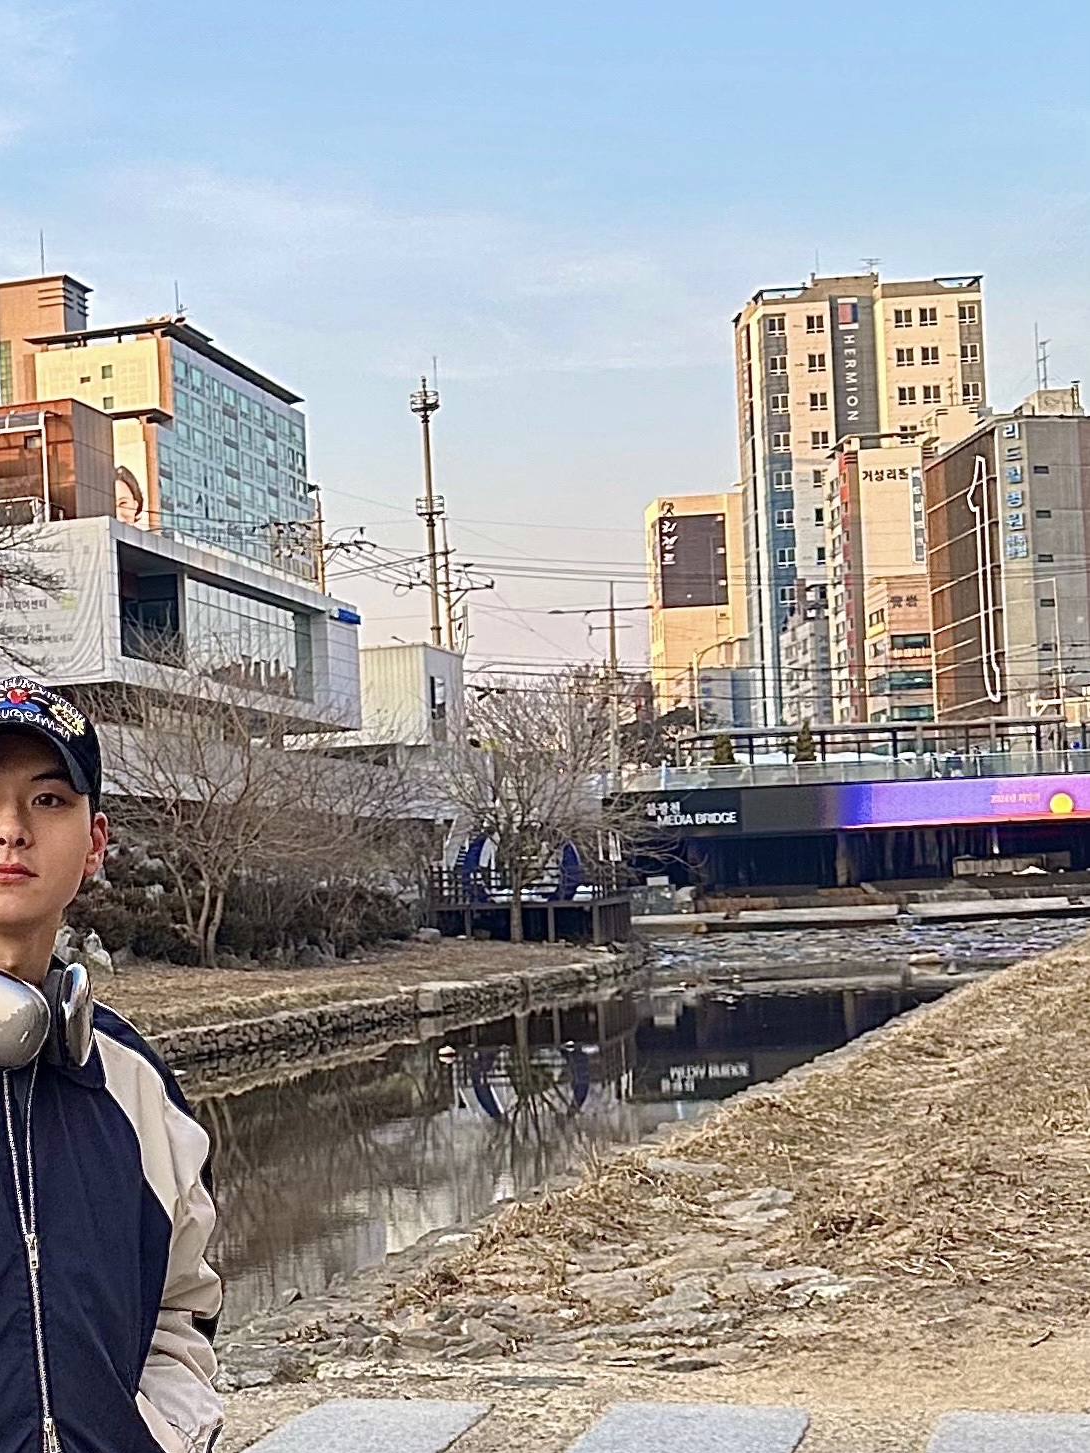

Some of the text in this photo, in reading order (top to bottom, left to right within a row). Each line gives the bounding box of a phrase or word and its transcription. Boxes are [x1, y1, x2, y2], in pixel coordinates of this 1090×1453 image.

[843, 334, 860, 421] HERMION
[657, 811, 738, 826] MEDIA BRIDGE
